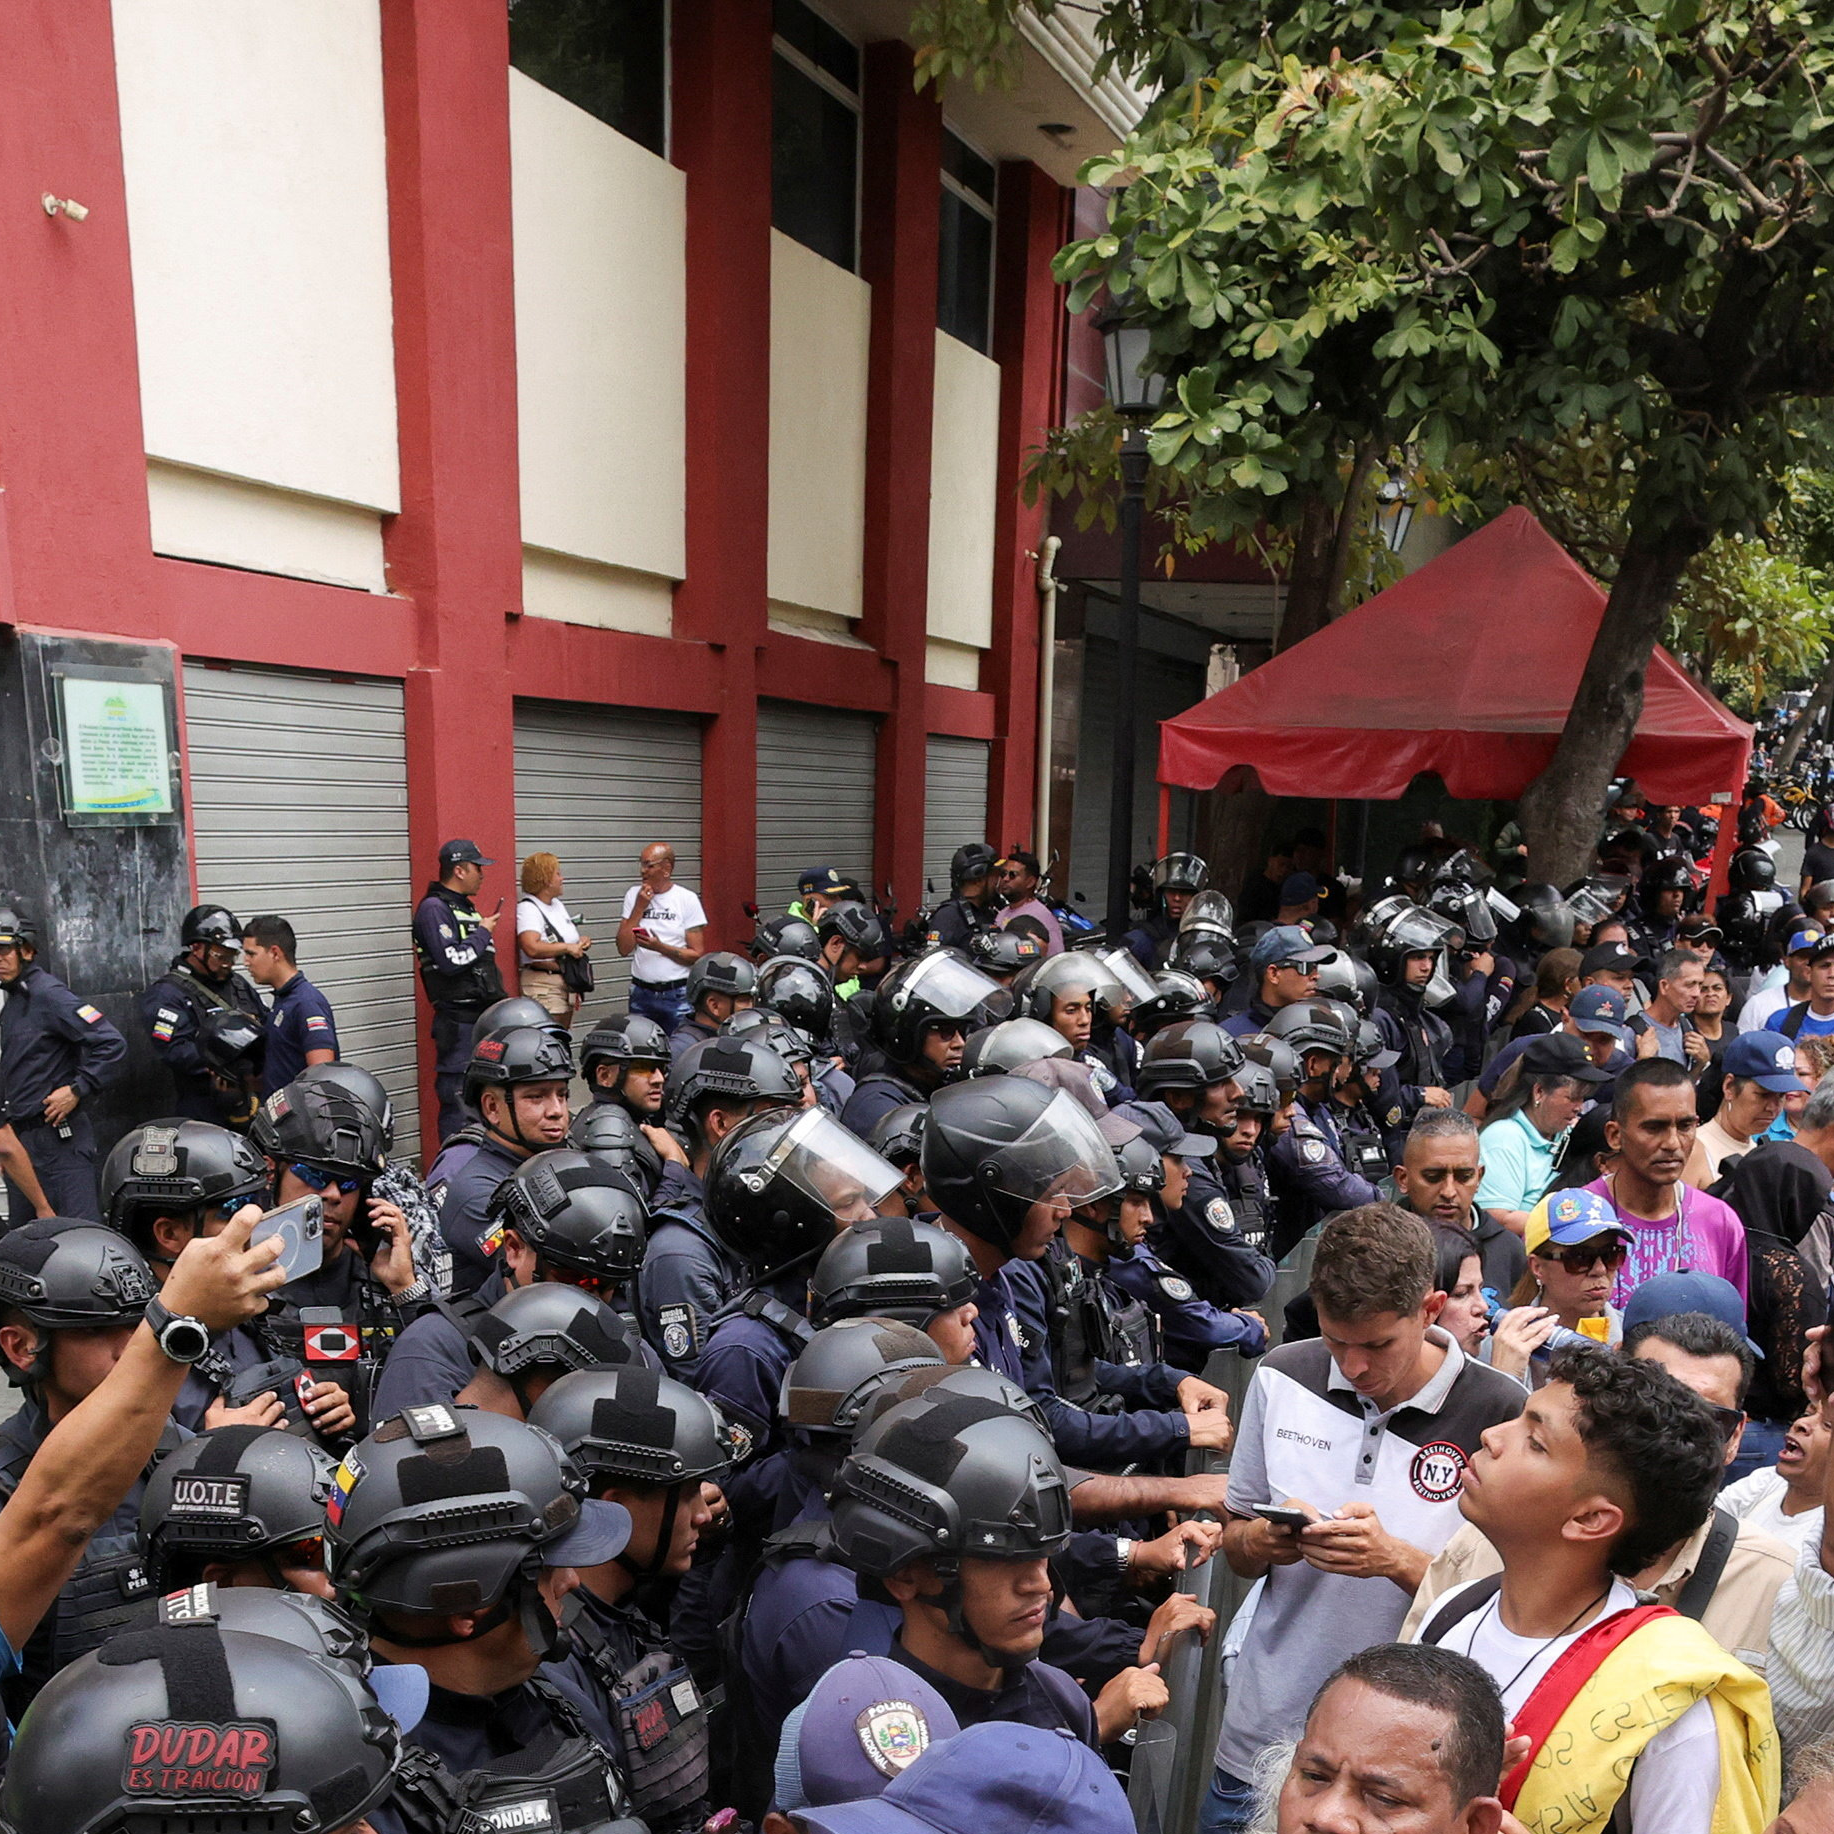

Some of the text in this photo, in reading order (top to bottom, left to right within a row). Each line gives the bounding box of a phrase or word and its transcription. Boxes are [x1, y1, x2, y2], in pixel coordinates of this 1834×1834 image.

[1276, 1428, 1332, 1451] BEETHOVEN
[1418, 1444, 1466, 1469] BEETHOVEN
[1423, 1463, 1454, 1485] N.Y
[1412, 1478, 1458, 1501] BEETHOVEN
[867, 1702, 915, 1719] POLICIA
[131, 1727, 271, 1767] DUDAR
[859, 1727, 889, 1771] NACIONAL
[129, 1768, 262, 1793] ES TRAICION
